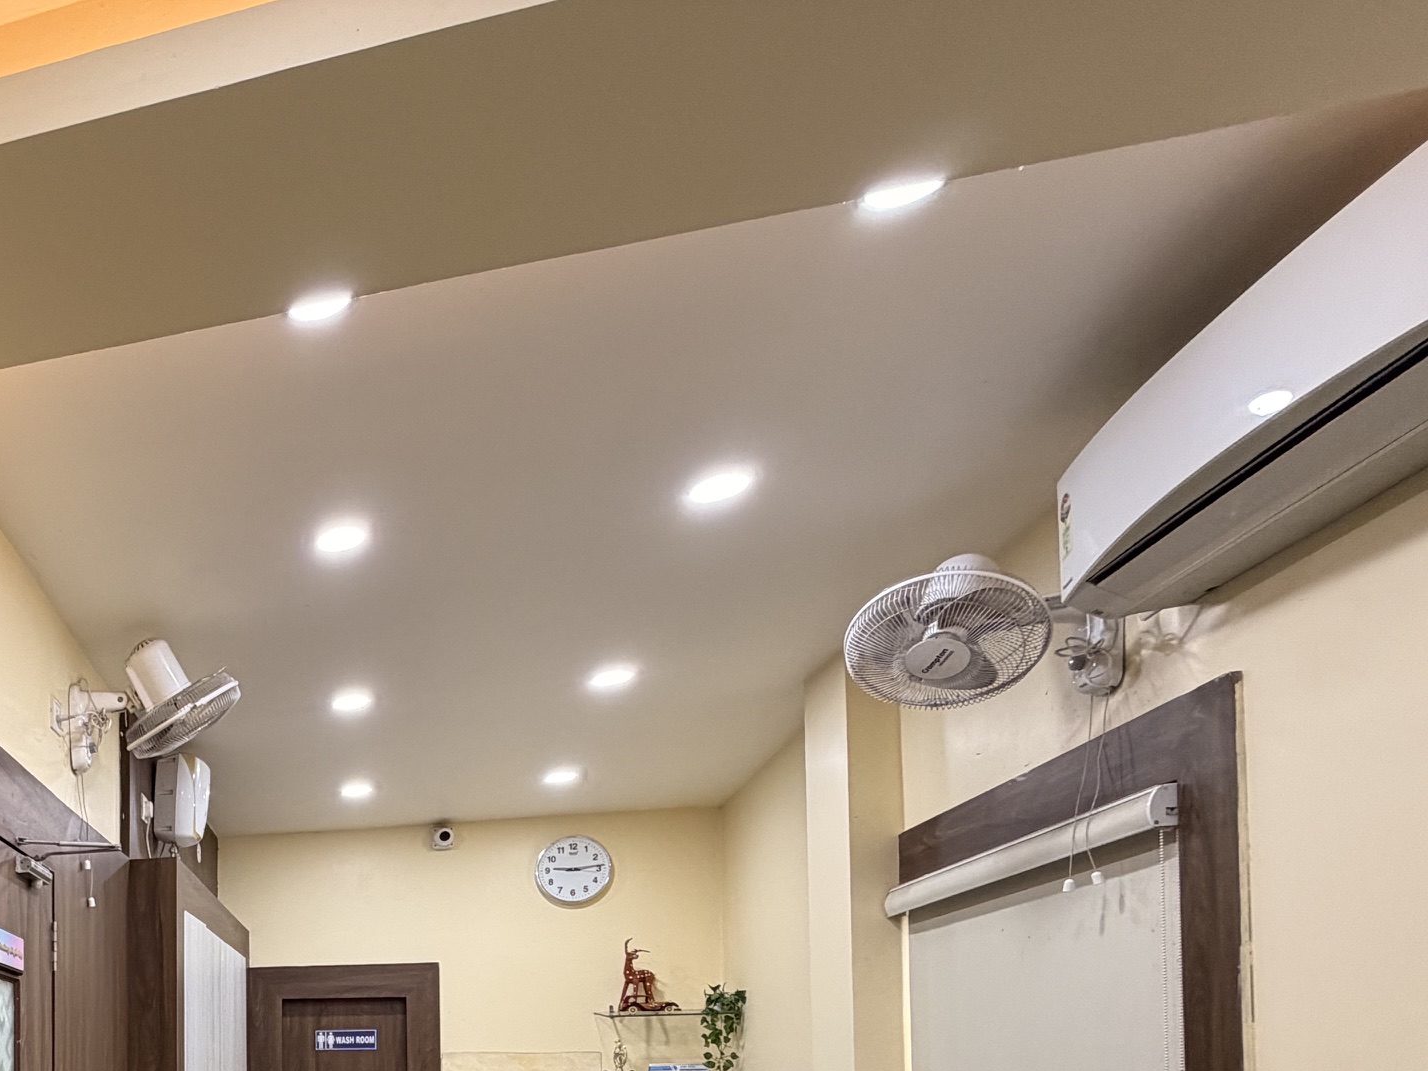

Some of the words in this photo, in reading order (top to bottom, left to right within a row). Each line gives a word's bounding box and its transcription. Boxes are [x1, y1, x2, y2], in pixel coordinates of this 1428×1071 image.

[557, 846, 565, 854] 11
[568, 842, 578, 851] 12
[584, 845, 588, 853] 1
[547, 855, 557, 863] 10
[592, 853, 599, 861] 2
[544, 867, 551, 875] 9
[596, 864, 602, 872] 3
[548, 878, 554, 886] 8
[592, 876, 598, 884] 4
[557, 886, 564, 894] 7
[570, 889, 576, 897] 6
[583, 885, 589, 893] 5
[335, 1036, 355, 1045] WASH
[355, 1035, 375, 1044] ROOM
